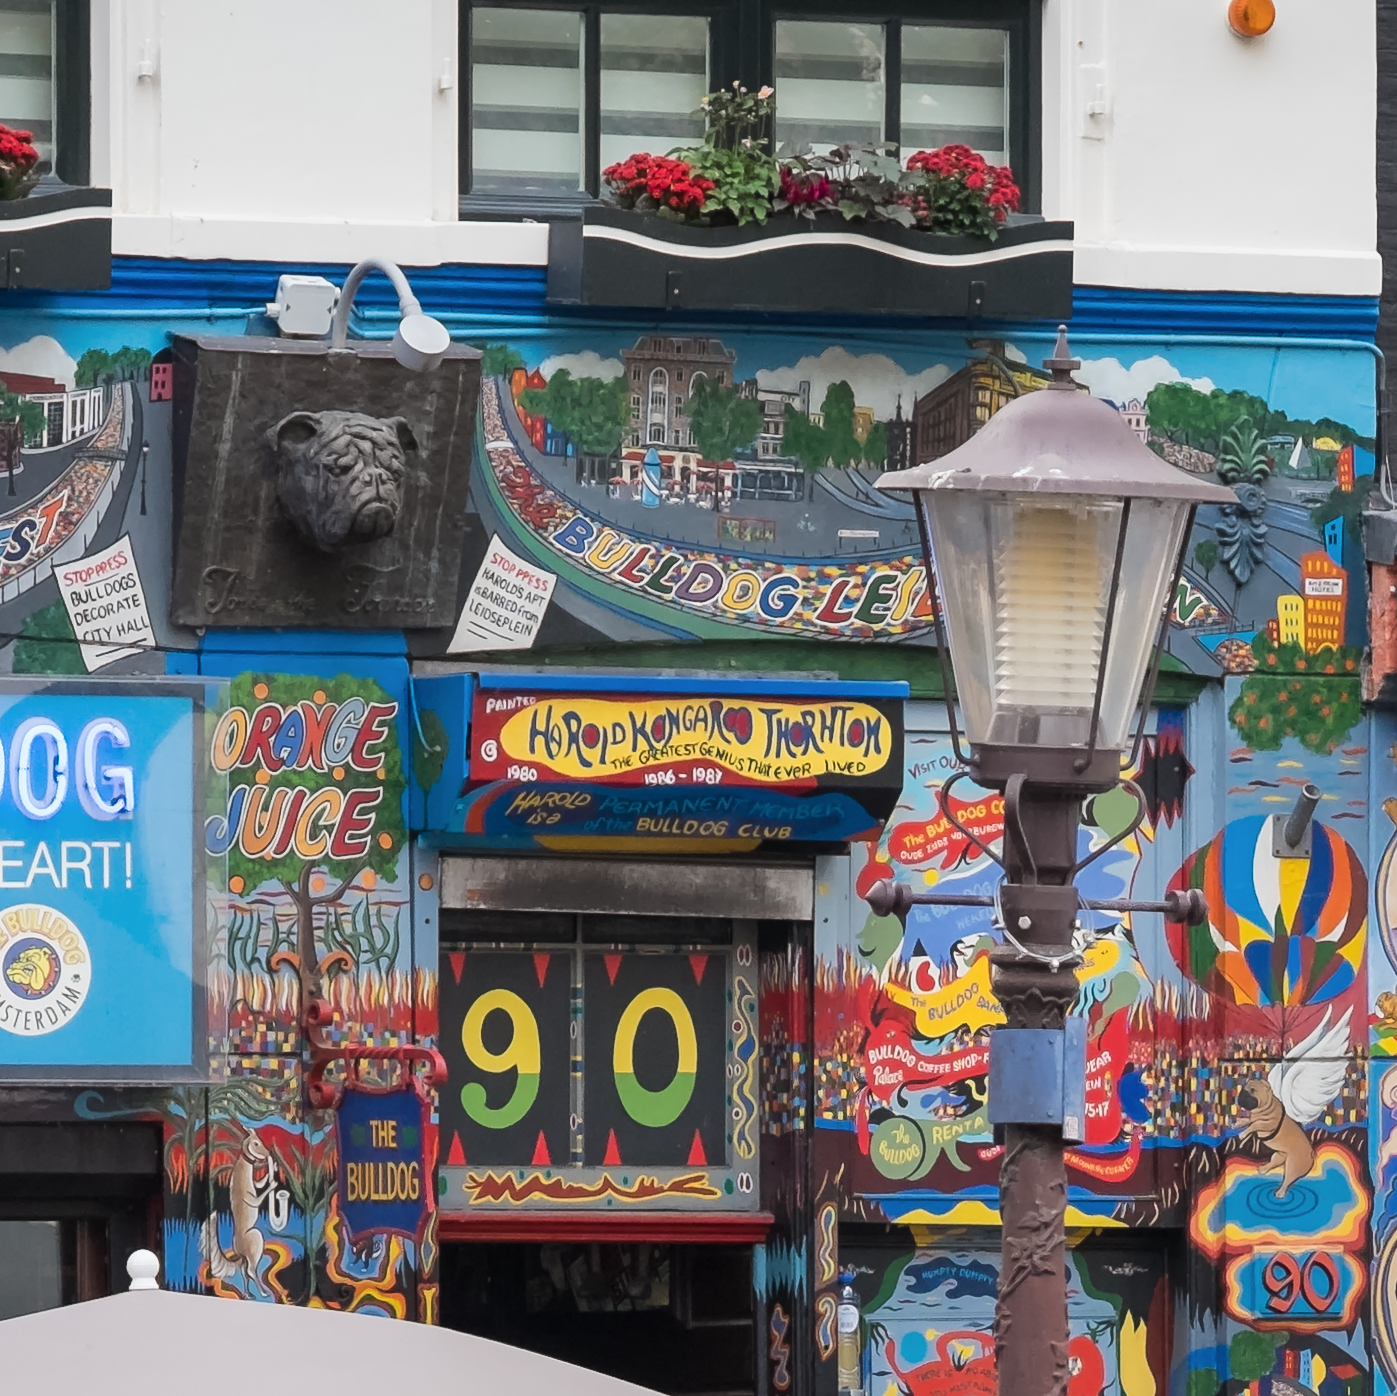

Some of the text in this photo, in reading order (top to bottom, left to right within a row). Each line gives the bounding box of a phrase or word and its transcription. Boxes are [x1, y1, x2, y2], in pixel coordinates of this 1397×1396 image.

[63, 567, 94, 587] STOP
[490, 552, 516, 574] STOP
[555, 516, 799, 620] BULLDOG
[70, 572, 137, 607] BULLDOGS
[480, 586, 518, 613] BARRED
[74, 593, 141, 627] DECORATE
[469, 598, 534, 637] LEIDSEPLEIN
[83, 615, 150, 642] CITY HALL
[486, 696, 538, 712] PAINTED
[210, 695, 399, 778] ORANGE
[611, 754, 633, 770] THE
[699, 741, 746, 771] GENIUS
[824, 760, 866, 776] LIVED
[908, 758, 938, 780] VISIT
[506, 766, 538, 783] 1980
[644, 769, 675, 786] 1986
[505, 791, 591, 817] HAROLD
[204, 783, 385, 861] JUICE
[636, 817, 730, 837] BULLDOG
[738, 821, 793, 840] CLUB
[900, 847, 925, 860] OUDE
[902, 832, 925, 849] The
[927, 982, 981, 1020] BULLDOG
[461, 989, 542, 1129] 9
[868, 1044, 951, 1075] BULLDOG COFFEE
[369, 1120, 398, 1148] THE
[879, 1141, 920, 1165] BULLDOG
[347, 1161, 421, 1203] BULLDOG
[1263, 1250, 1340, 1314] 90
